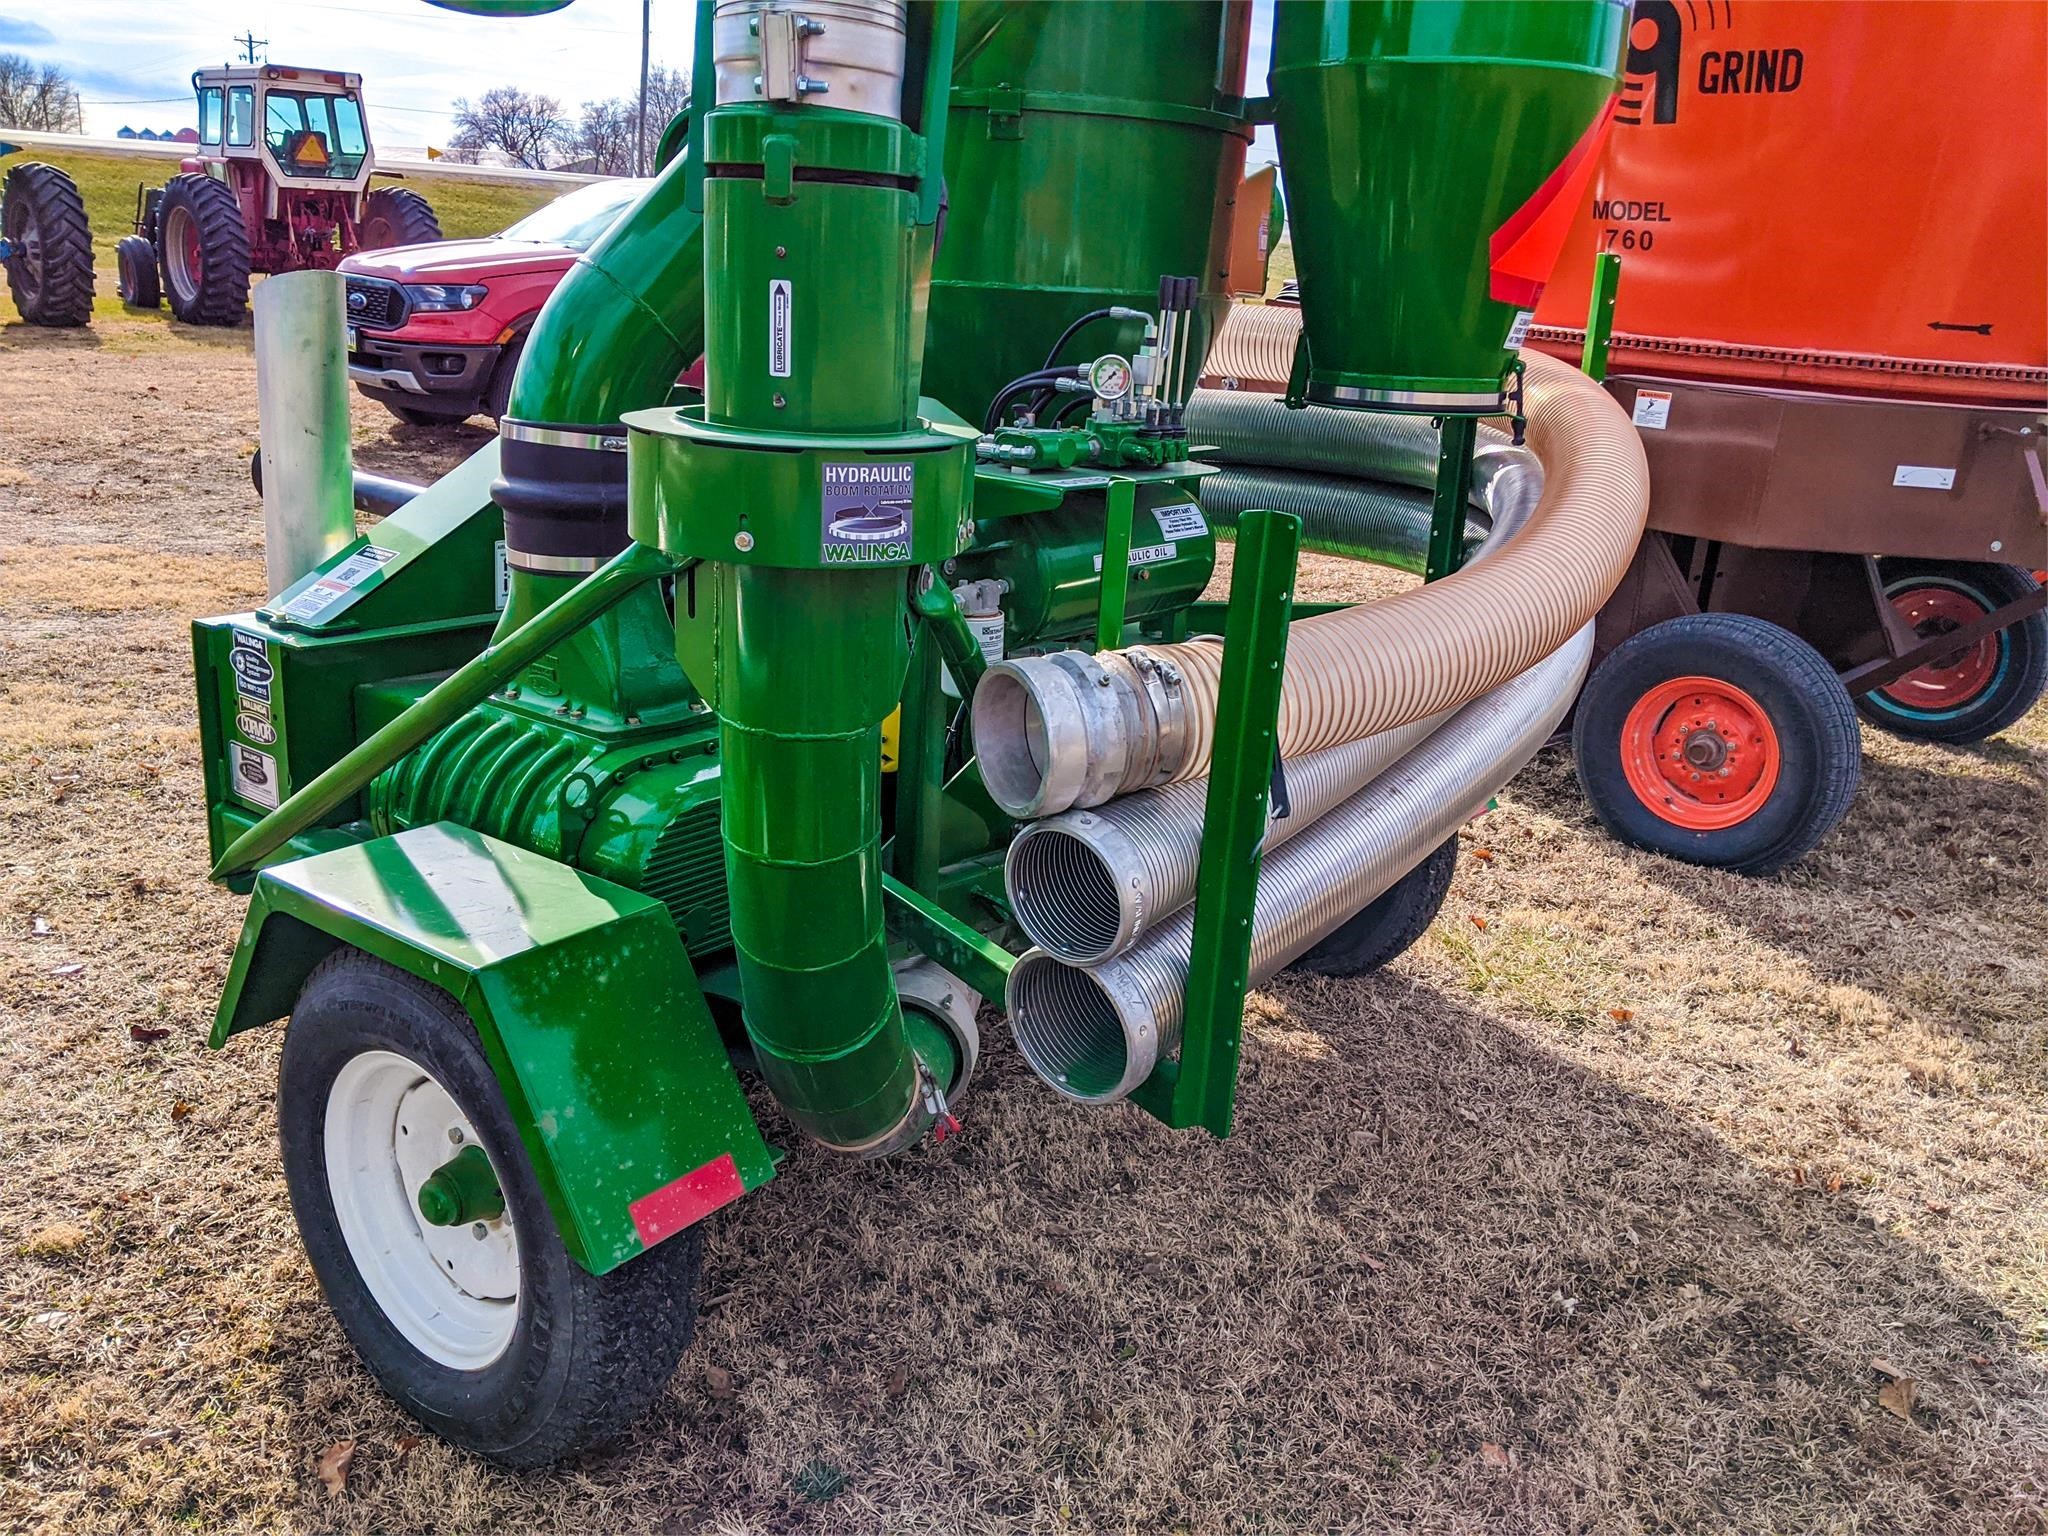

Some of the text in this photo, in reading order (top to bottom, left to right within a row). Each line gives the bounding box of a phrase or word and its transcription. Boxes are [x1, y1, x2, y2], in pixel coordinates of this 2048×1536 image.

[1698, 48, 1804, 94] GRIND
[1593, 200, 1671, 222] MODEL
[1605, 229, 1653, 251] 760
[825, 466, 912, 482] HYDRAULIC
[825, 484, 911, 496] BOOM ROTATION
[1160, 507, 1192, 517] IMPORTANT
[823, 541, 911, 562] WALINGA
[1154, 548, 1168, 557] OIL
[236, 633, 263, 650] WALINGA
[246, 661, 270, 675] Management
[242, 697, 267, 716] WALINGA
